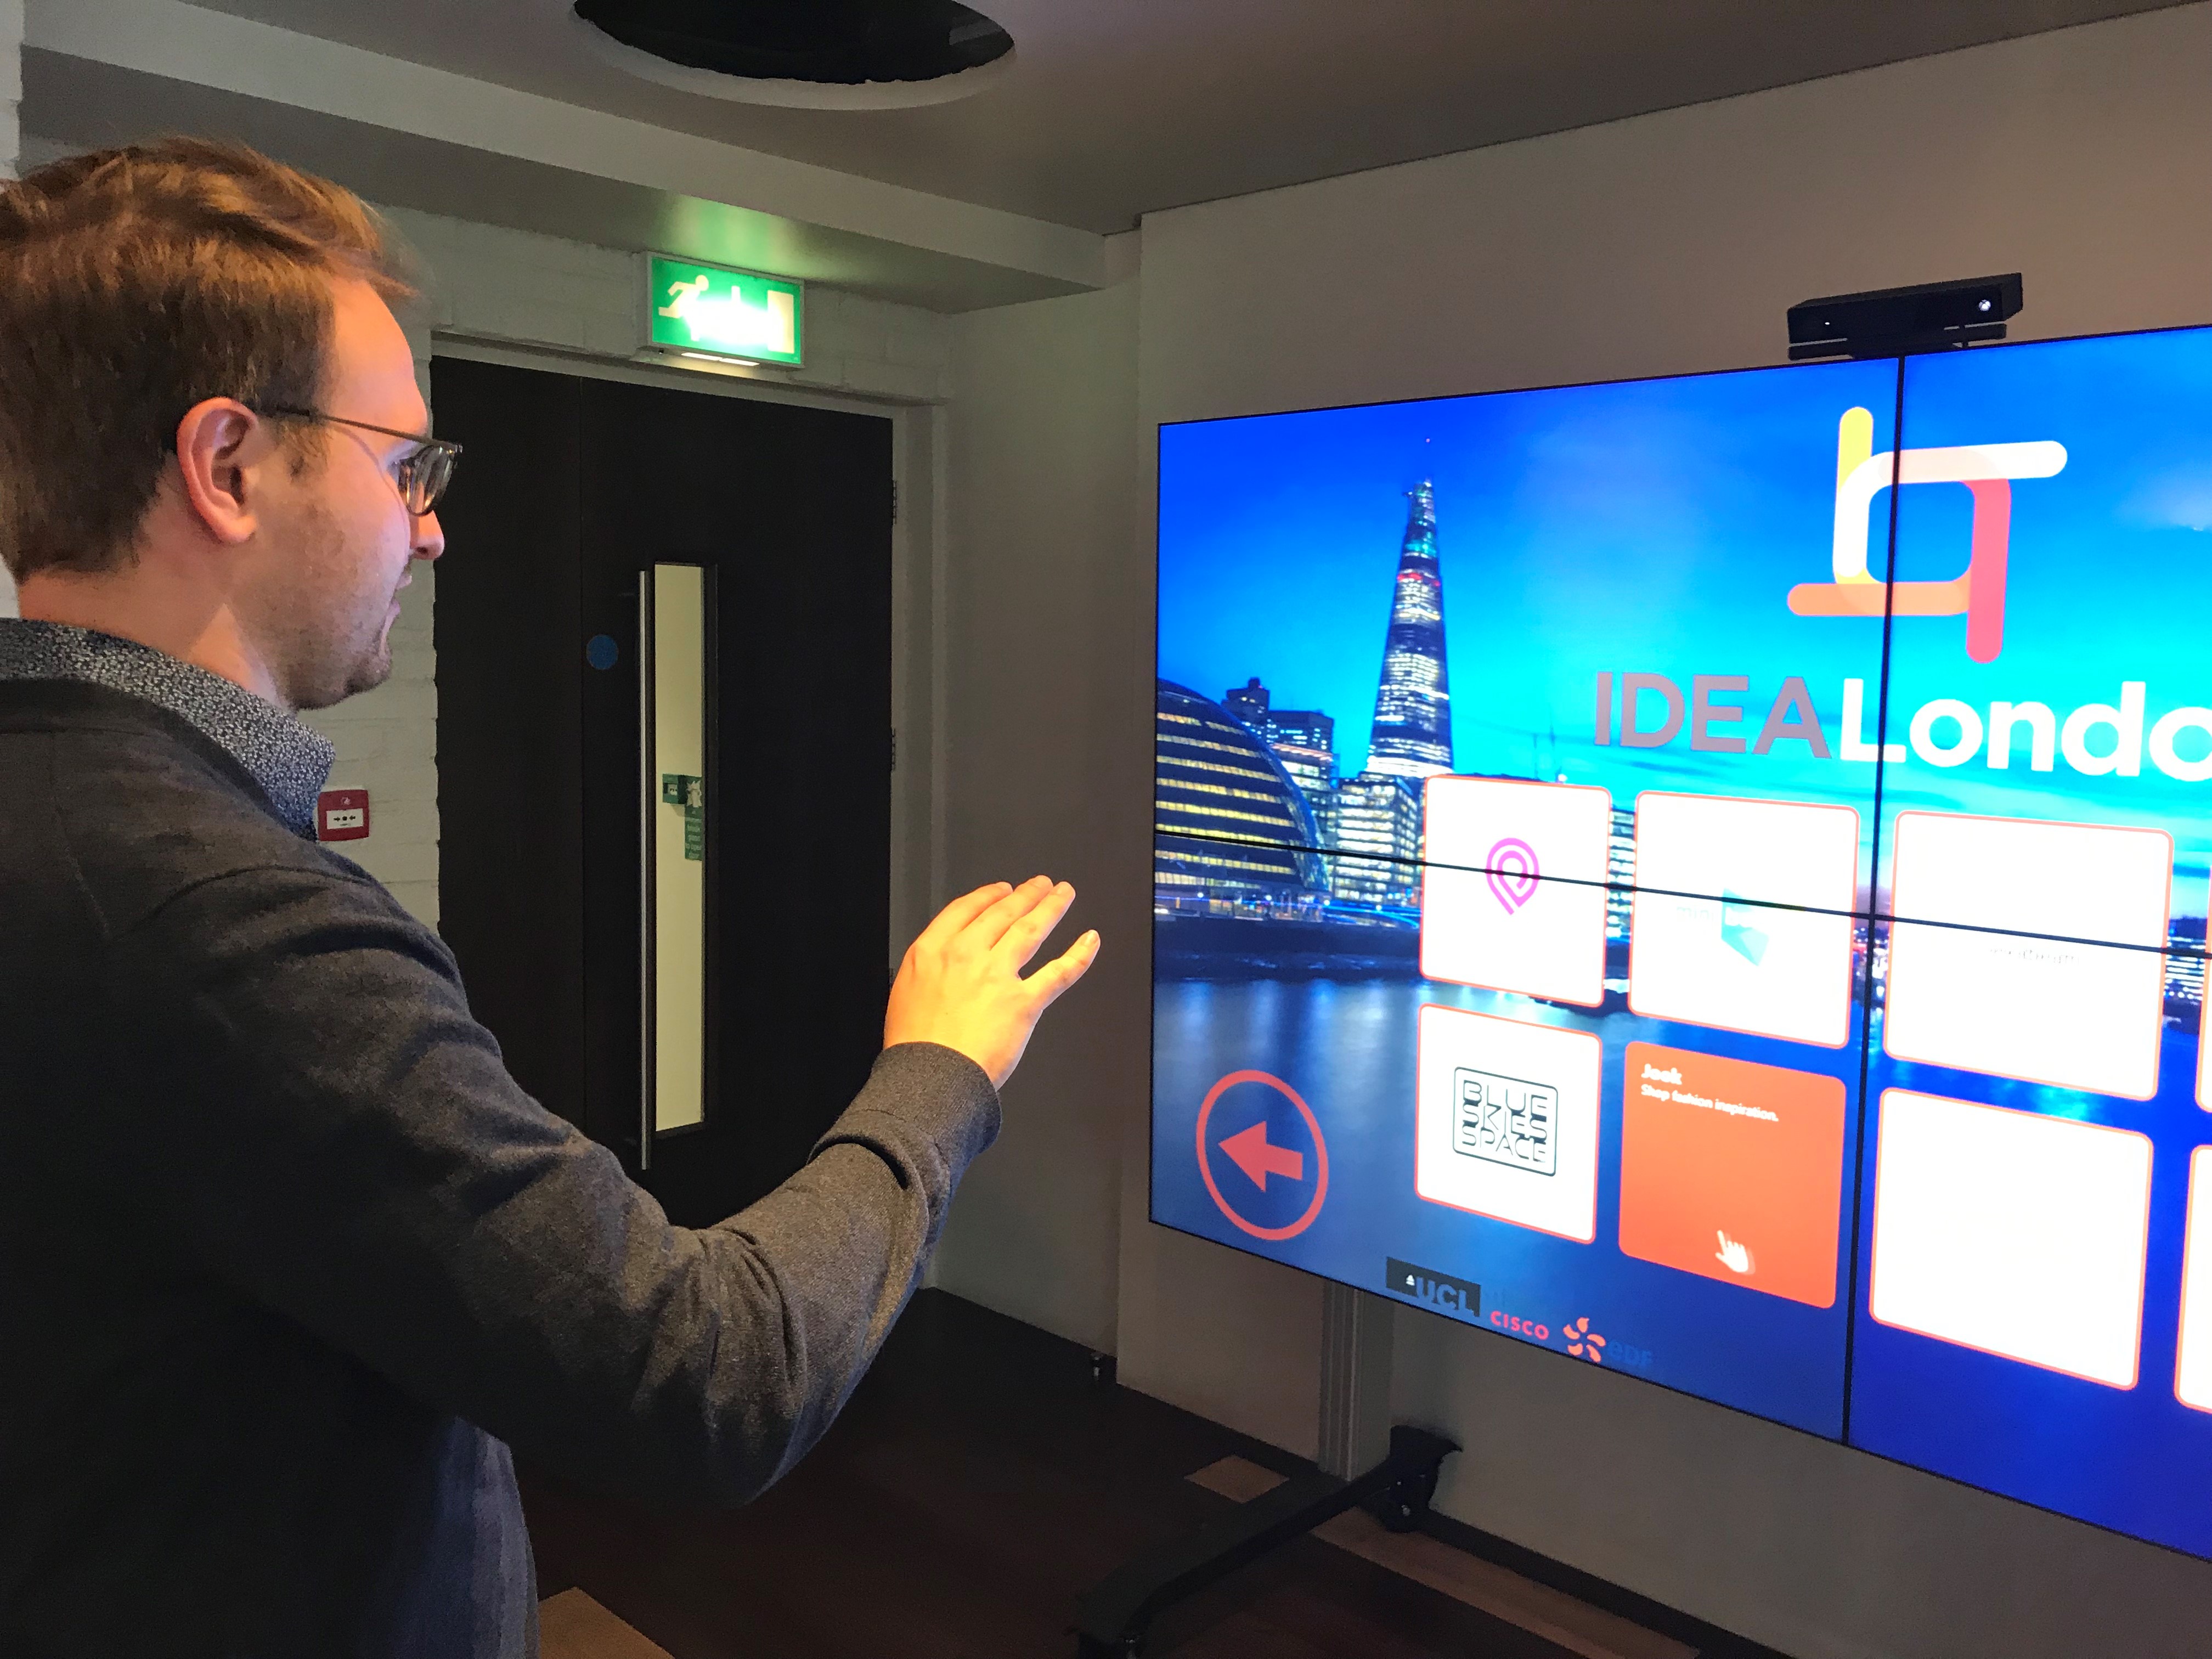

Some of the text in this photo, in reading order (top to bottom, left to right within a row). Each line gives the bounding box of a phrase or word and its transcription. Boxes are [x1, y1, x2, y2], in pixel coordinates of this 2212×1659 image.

[1463, 1079, 1548, 1118] BLUE
[1641, 1084, 1779, 1122] Shop fashion inspiration.
[1462, 1099, 1547, 1143] SKIES
[1462, 1124, 1547, 1163] SPACE
[1415, 1277, 1476, 1316] UCL
[1490, 1311, 1549, 1340] CISCO
